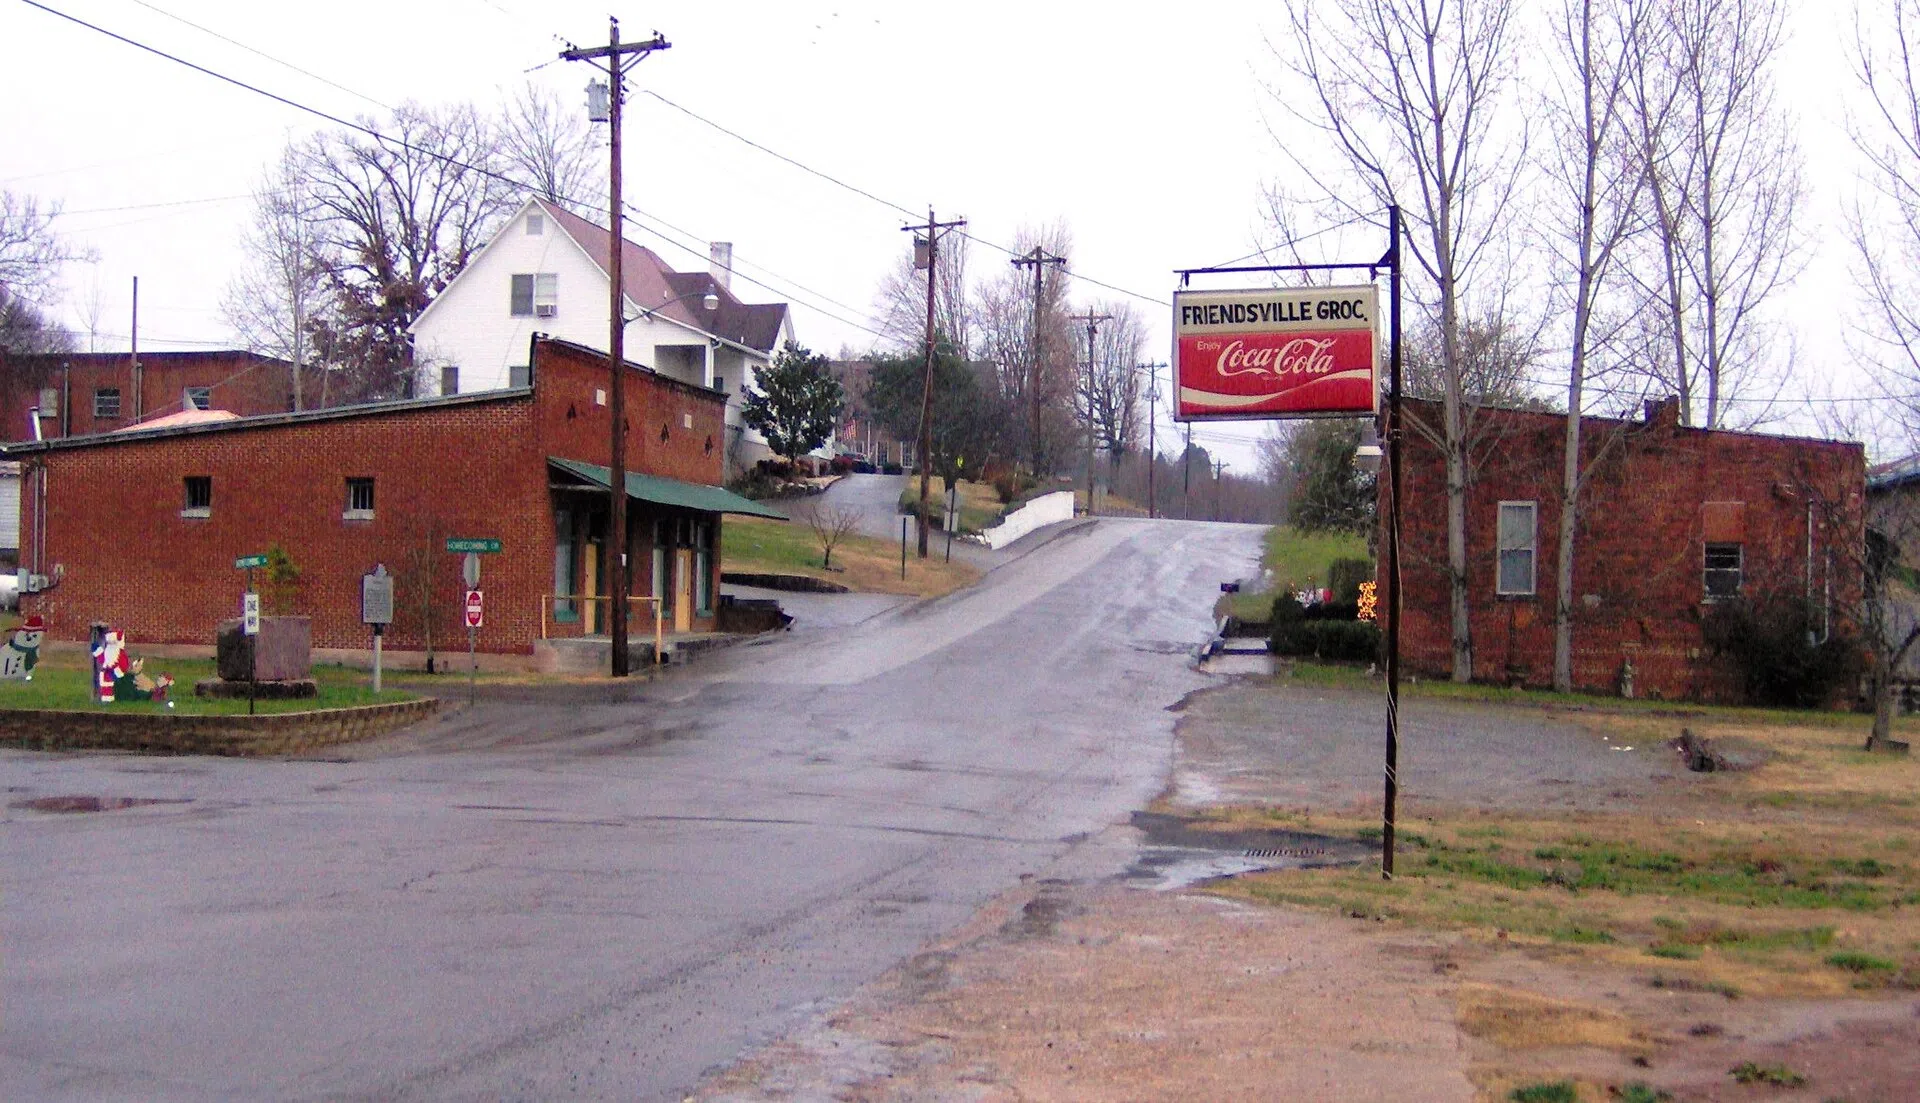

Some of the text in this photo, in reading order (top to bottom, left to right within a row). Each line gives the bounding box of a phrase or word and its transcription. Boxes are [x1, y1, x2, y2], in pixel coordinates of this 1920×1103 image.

[1182, 299, 1368, 325] FRIENDSVILLE GROC.
[1196, 340, 1221, 351] Enjoy
